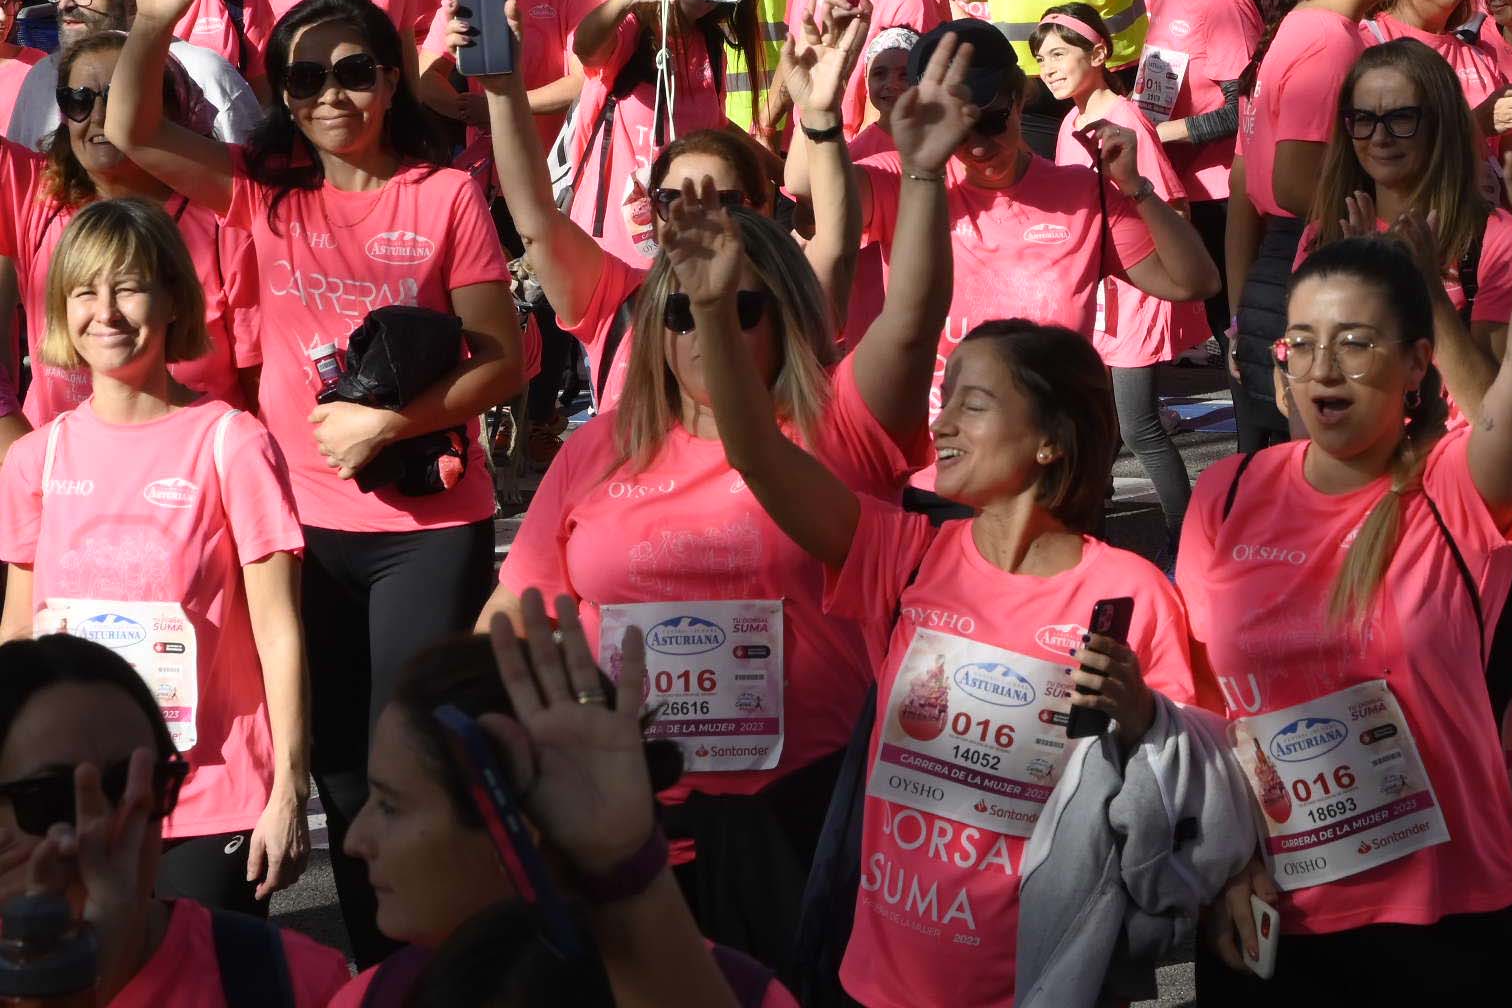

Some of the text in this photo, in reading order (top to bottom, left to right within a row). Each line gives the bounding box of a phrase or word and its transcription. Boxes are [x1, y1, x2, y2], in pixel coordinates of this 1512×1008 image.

[371, 243, 431, 256] ASTURIANA
[270, 259, 397, 315] CARRERA
[1232, 544, 1307, 566] OYSHO
[80, 628, 141, 641] ASTURIANA
[153, 622, 184, 632] SUMA
[732, 623, 769, 633] SUMA
[651, 634, 720, 648] ASTURIANA
[655, 669, 718, 693] 016
[960, 669, 1028, 703] ASTURIANA
[662, 700, 710, 716] 26616
[1351, 702, 1388, 721] SUMA
[667, 721, 764, 733] DE LA MUJER 2023
[951, 711, 1017, 749] 016
[710, 744, 769, 758] Santander
[1276, 728, 1344, 758] ASTURIANA
[952, 744, 1002, 772] 14052
[901, 753, 1023, 795] CARRERA DE LA MUJER
[1292, 764, 1357, 803] 016
[888, 774, 945, 802] OYSHO
[1307, 797, 1358, 824] 18693
[1281, 799, 1418, 849] CARRERA DE LA MUJER 2023
[1371, 821, 1431, 850] Santander
[1283, 856, 1328, 876] OYSHO
[862, 852, 976, 930] SUMA
[953, 933, 981, 946] 2023
